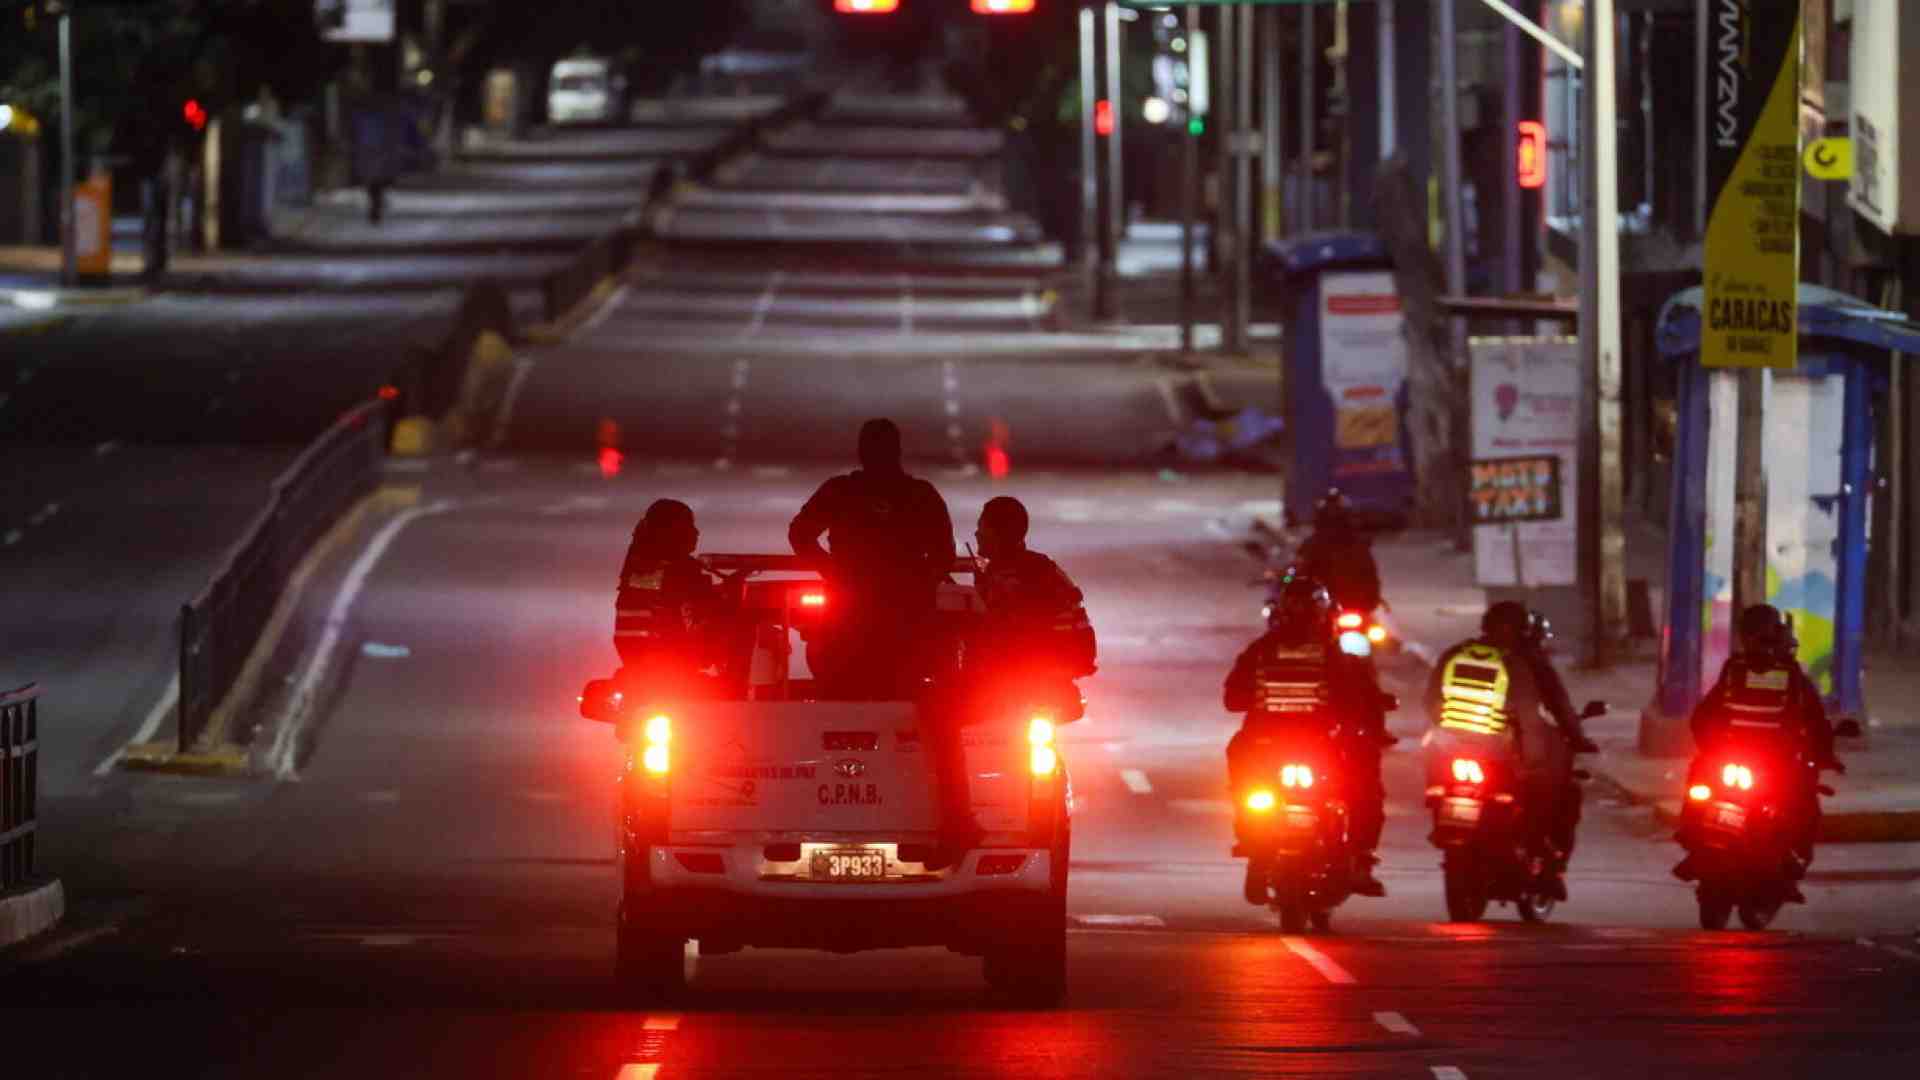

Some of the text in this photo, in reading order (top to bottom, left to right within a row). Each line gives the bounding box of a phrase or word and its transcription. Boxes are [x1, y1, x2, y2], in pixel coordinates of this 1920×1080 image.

[1711, 297, 1792, 333] CARACAS
[817, 783, 883, 805] C.P.N.B.
[829, 855, 883, 876] 3P933
